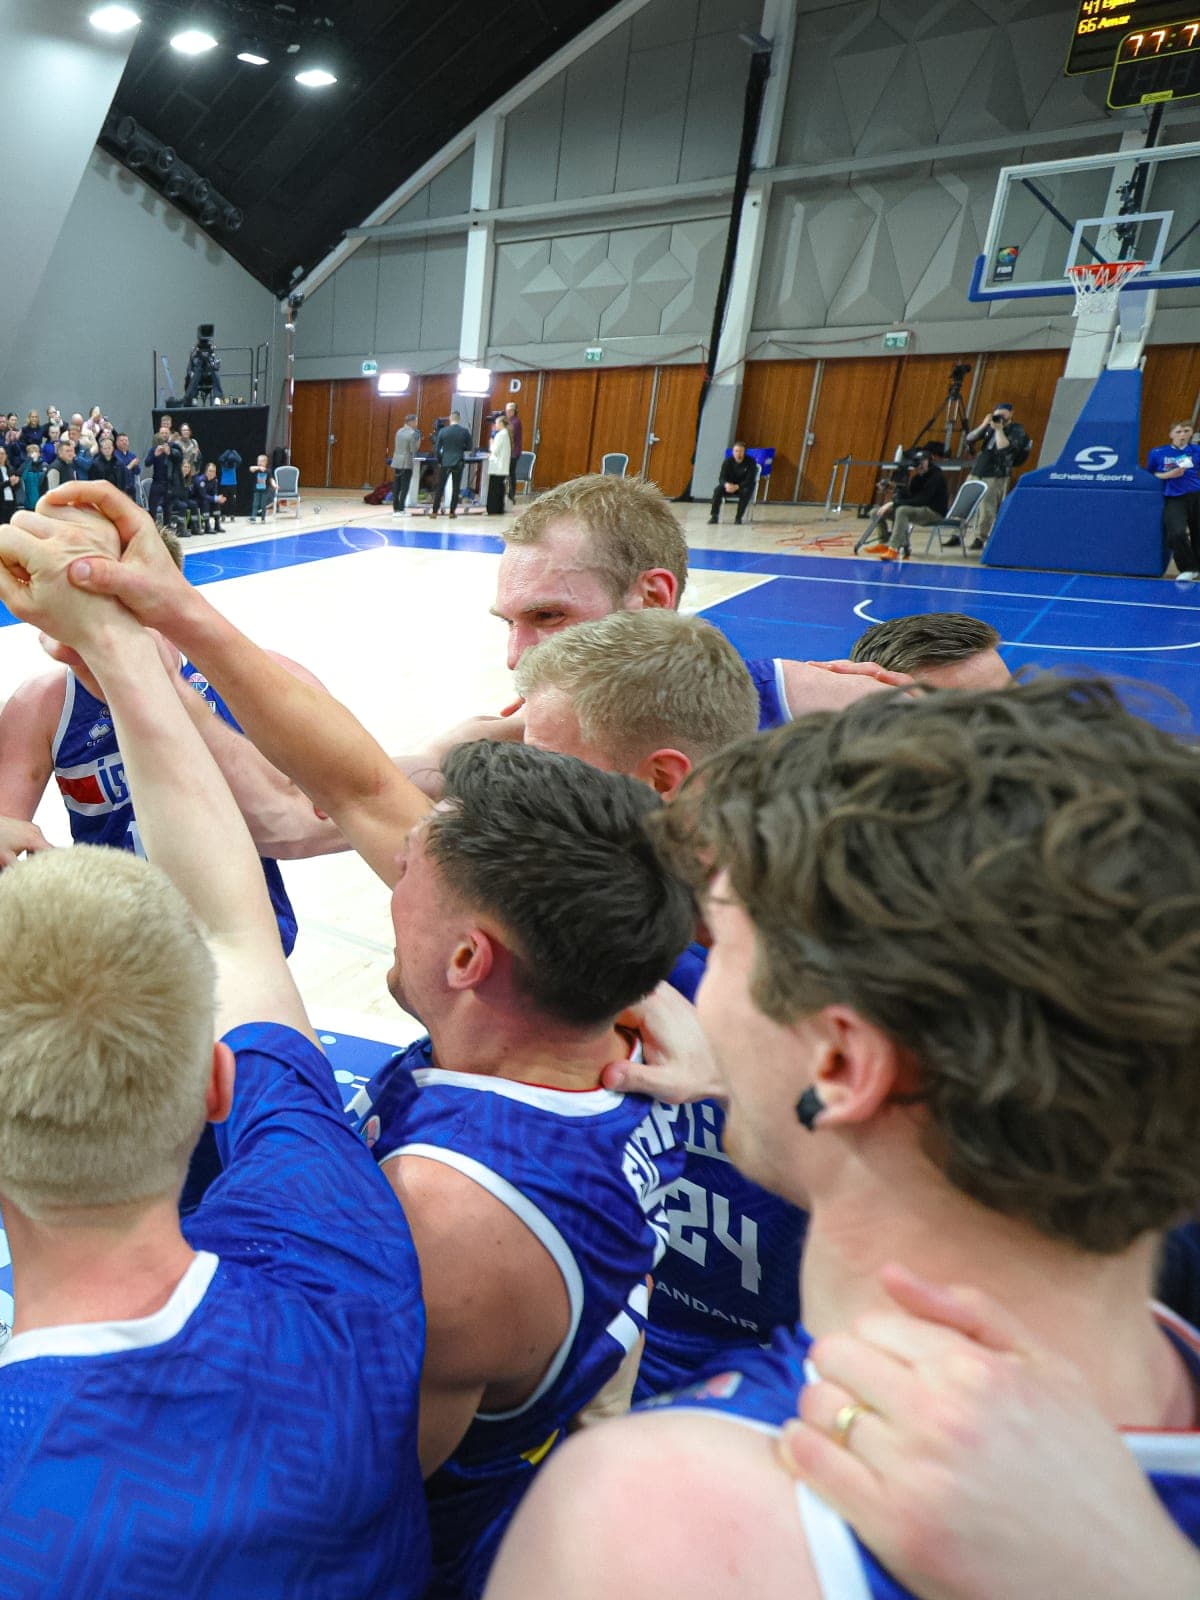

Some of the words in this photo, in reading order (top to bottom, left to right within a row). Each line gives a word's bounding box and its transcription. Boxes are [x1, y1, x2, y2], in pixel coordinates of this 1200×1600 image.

[1078, 17, 1098, 34] 66
[509, 378, 522, 394] D
[1050, 472, 1094, 481] Schelde
[1096, 473, 1134, 482] Sports
[659, 1176, 762, 1296] 24
[655, 1279, 760, 1334] ANDAIR
